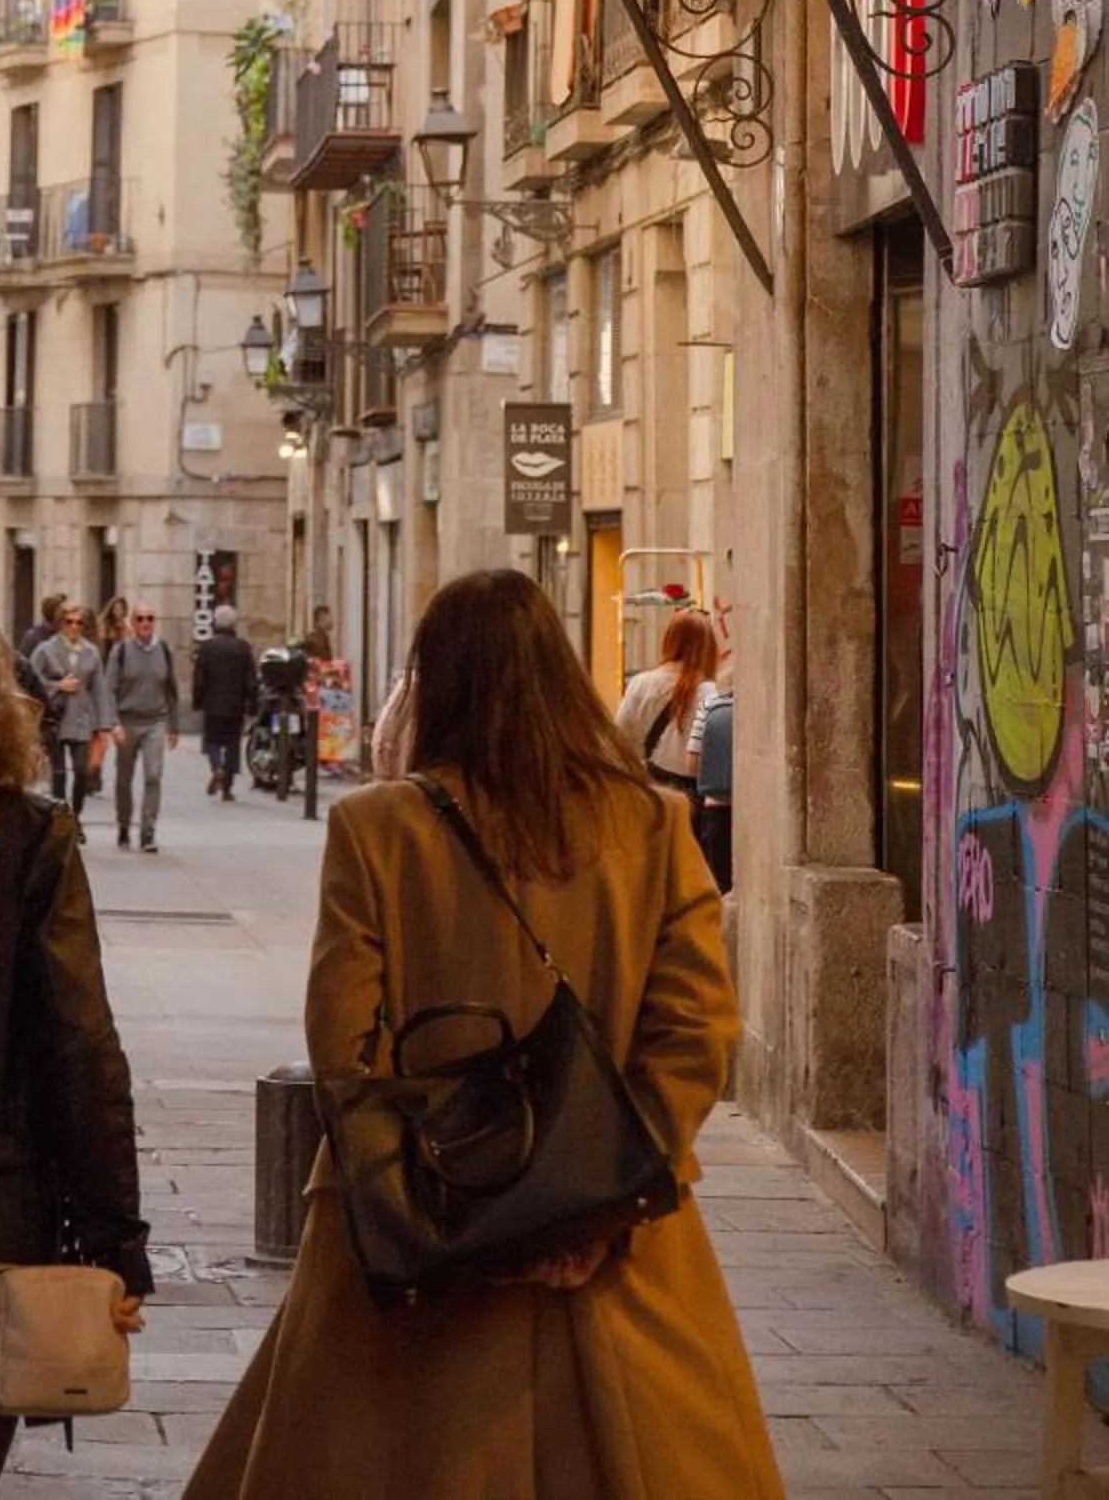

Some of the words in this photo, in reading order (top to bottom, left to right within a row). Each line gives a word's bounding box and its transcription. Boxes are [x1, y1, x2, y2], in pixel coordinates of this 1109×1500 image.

[511, 423, 526, 433] LA
[511, 433, 527, 443] DE
[530, 433, 565, 443] PLATA
[193, 548, 216, 641] TATTOO
